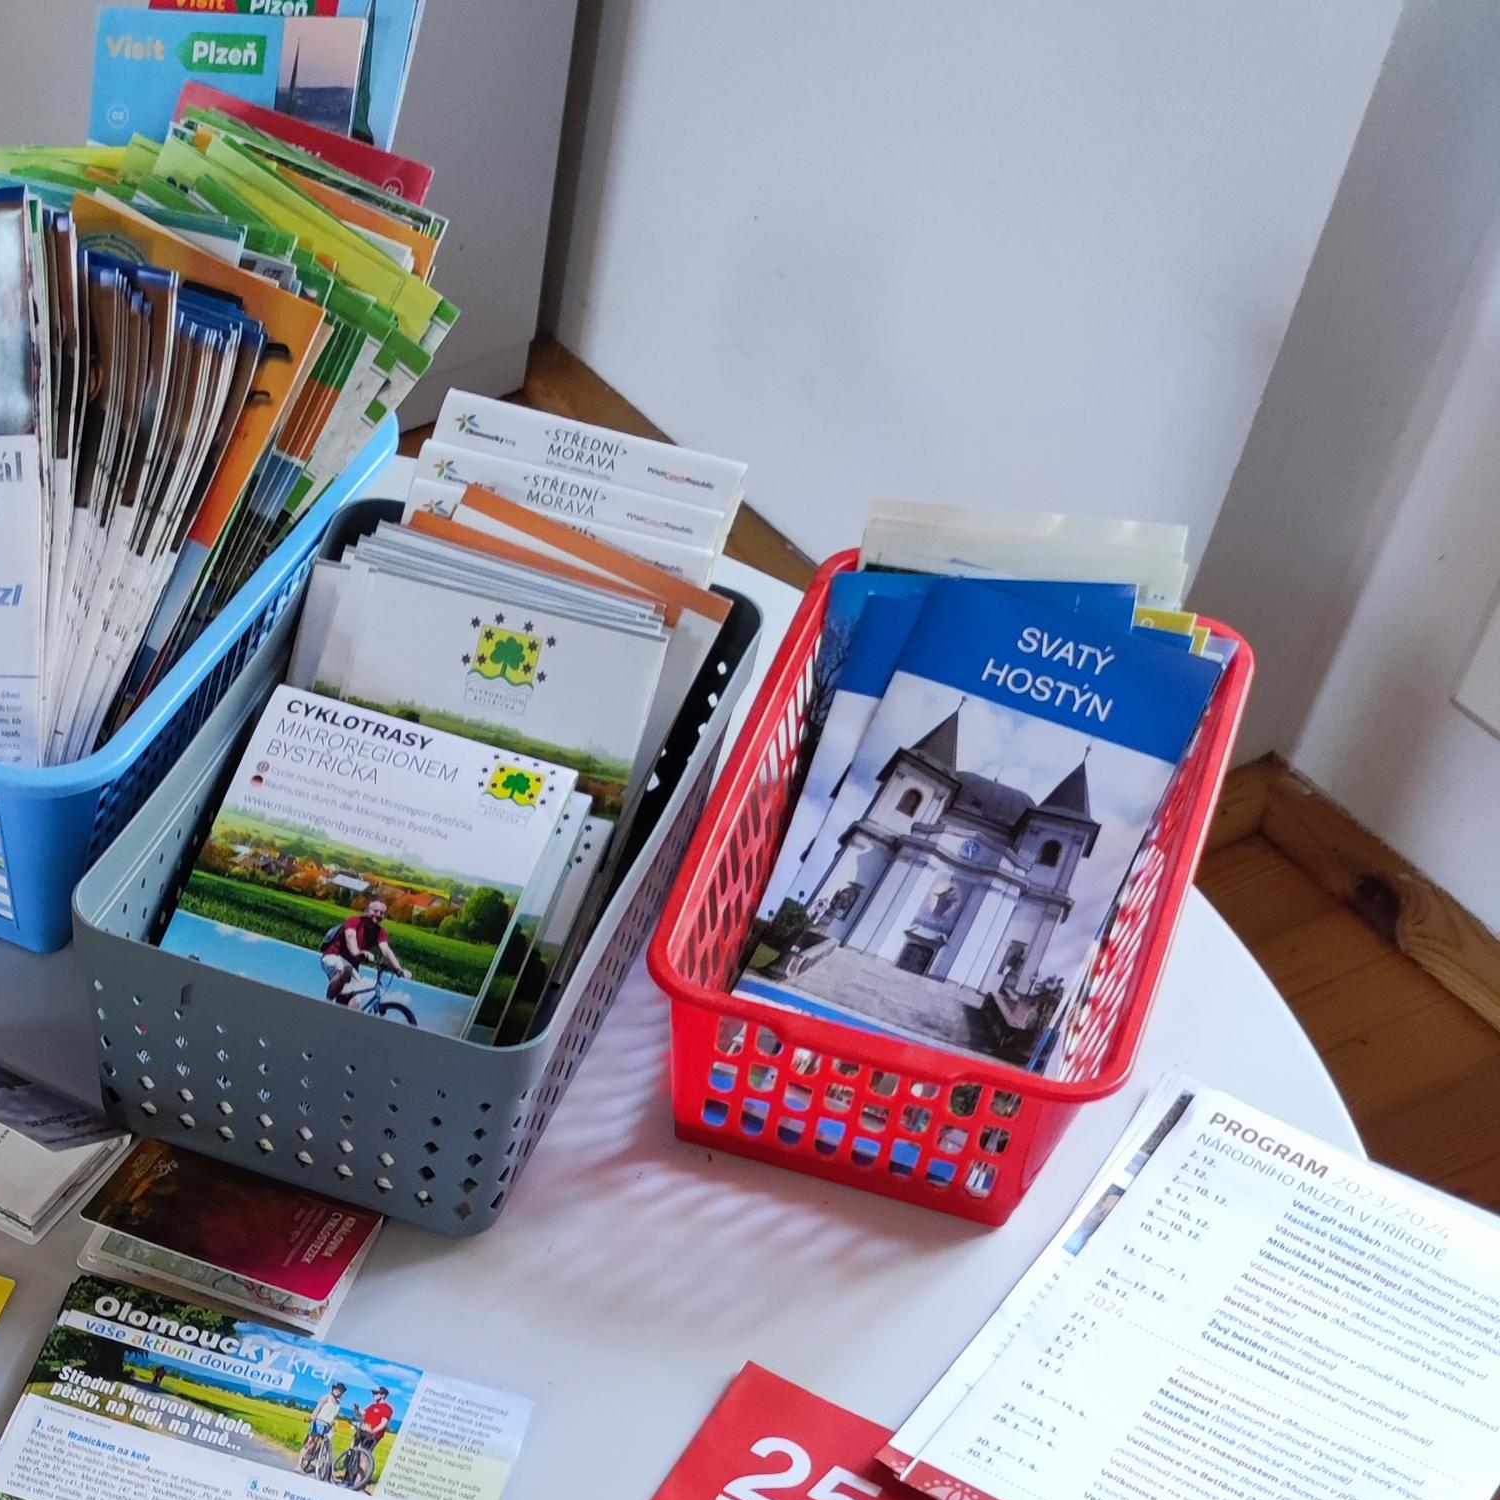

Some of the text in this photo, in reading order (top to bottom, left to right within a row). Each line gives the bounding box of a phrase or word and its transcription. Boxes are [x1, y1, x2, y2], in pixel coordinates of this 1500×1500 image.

[107, 32, 258, 66] Visit Plzeň
[547, 445, 615, 471] MORAVA
[552, 429, 619, 456] STŘEDNÍ
[526, 489, 595, 518] MORAVA
[530, 474, 598, 502] STŘEDNÍ
[1017, 627, 1115, 676] SVATÝ
[982, 658, 1113, 722] HOSTÝN
[287, 699, 434, 751] CYKLOTRASY
[266, 737, 379, 785] BYSTŘIČKA
[276, 717, 459, 784] MIKROREGIONEM
[243, 793, 404, 849] www.mikroregionbystricka.cz
[1197, 1132, 1449, 1262] NÁRODNÍHO MUZEA V PŘÍRODĚ
[1209, 1111, 1450, 1241] PROGRAM 2023/2024
[1291, 1199, 1382, 1248] Večer při svíčkách
[85, 1319, 283, 1386] vaše aktivní dovolená
[94, 1295, 338, 1385] Olomoucký kraj
[59, 1365, 116, 1394] Střední
[120, 1382, 189, 1418] Moravou
[191, 1407, 212, 1424] na
[215, 1411, 254, 1438] kole,
[105, 1398, 127, 1415] na
[129, 1401, 163, 1428] lodi,
[168, 1418, 189, 1436] na
